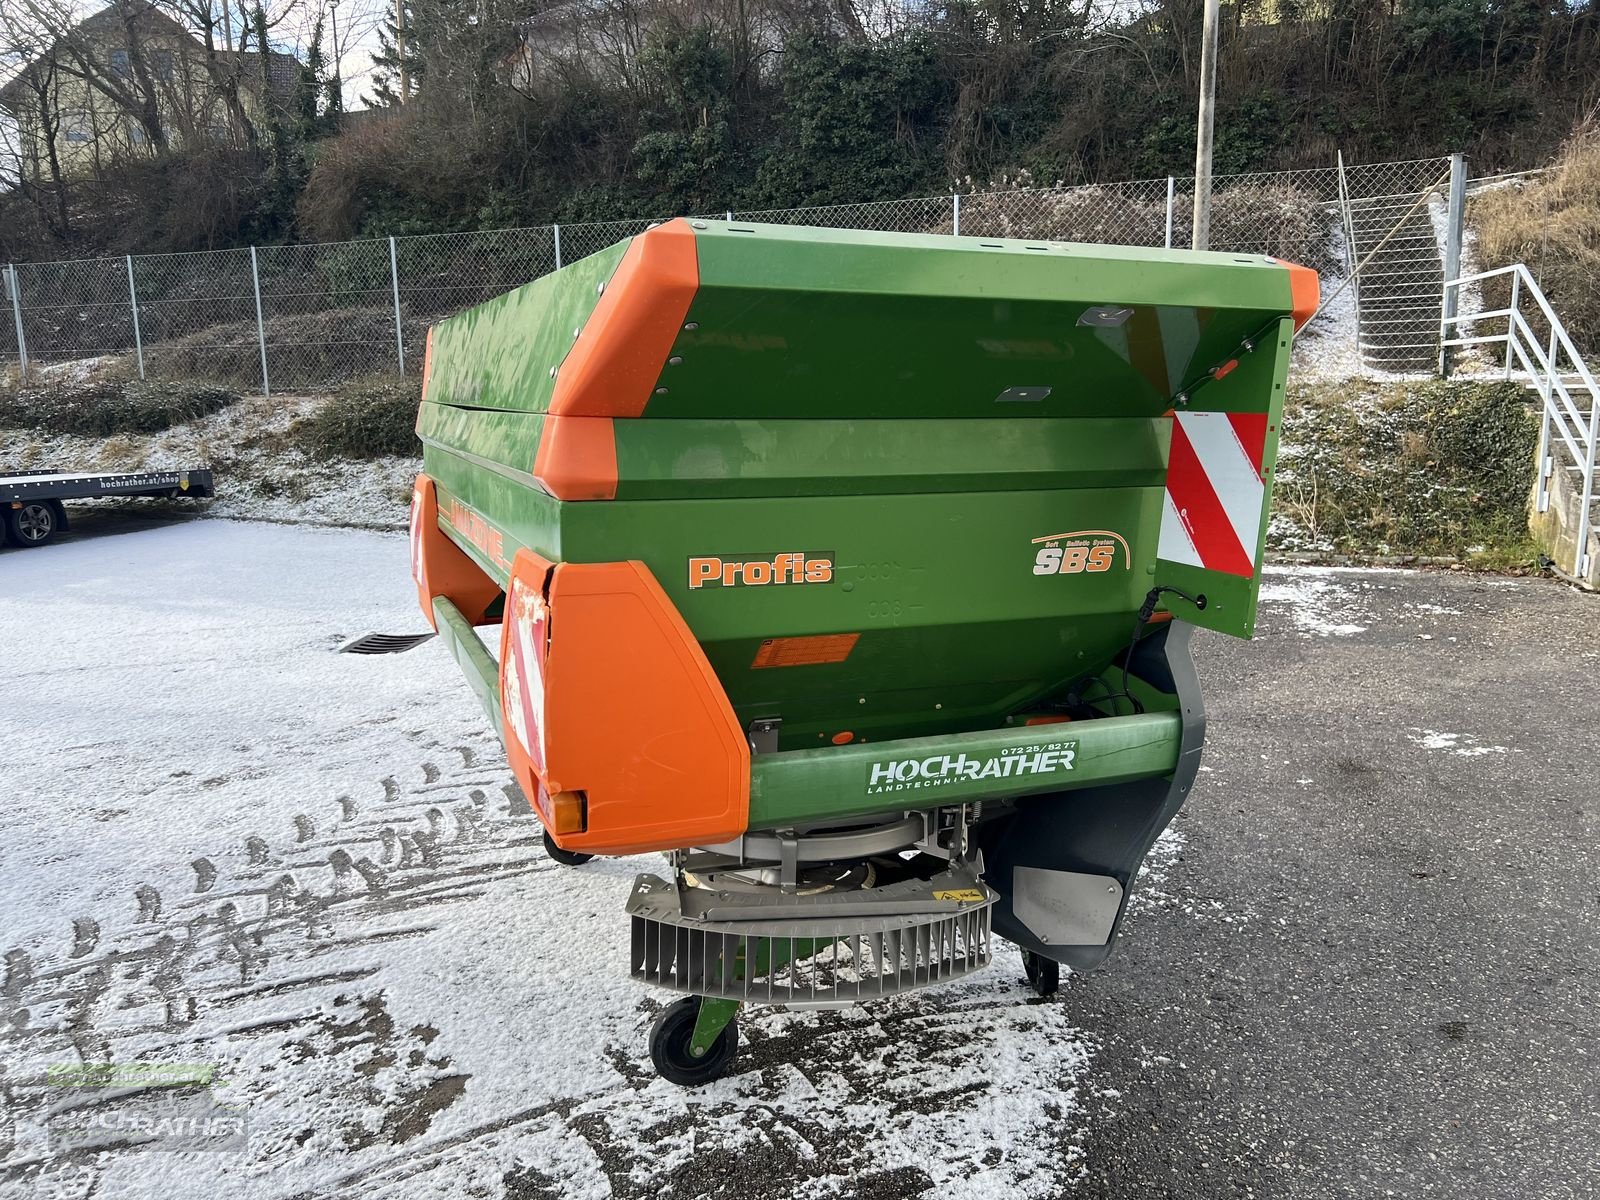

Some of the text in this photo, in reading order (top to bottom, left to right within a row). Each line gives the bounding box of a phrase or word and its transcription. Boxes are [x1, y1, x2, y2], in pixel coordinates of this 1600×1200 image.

[100, 476, 179, 488] hochrather.at/shop
[1092, 539, 1115, 547] System
[689, 553, 832, 588] Profis
[1032, 545, 1115, 576] SBS
[869, 750, 1077, 786] HOCHRATHER
[867, 775, 968, 794] LANDTECHNIK
